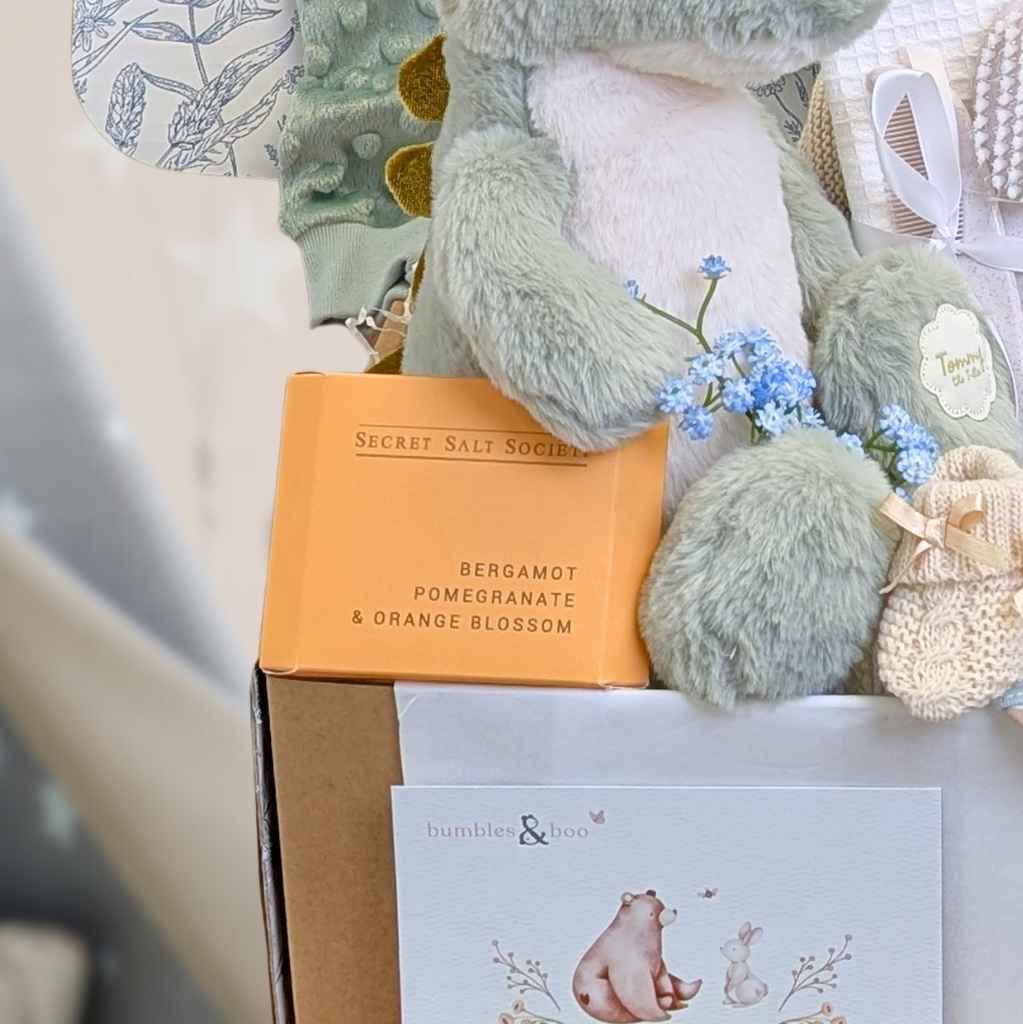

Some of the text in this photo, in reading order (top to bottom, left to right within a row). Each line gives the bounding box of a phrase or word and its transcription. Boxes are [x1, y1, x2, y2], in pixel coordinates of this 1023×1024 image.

[505, 438, 588, 457] SOCIET
[460, 561, 577, 581] BERGAMOT
[414, 586, 576, 608] POMEGRANATE
[351, 610, 572, 634] & ORANGE BLOSSOM
